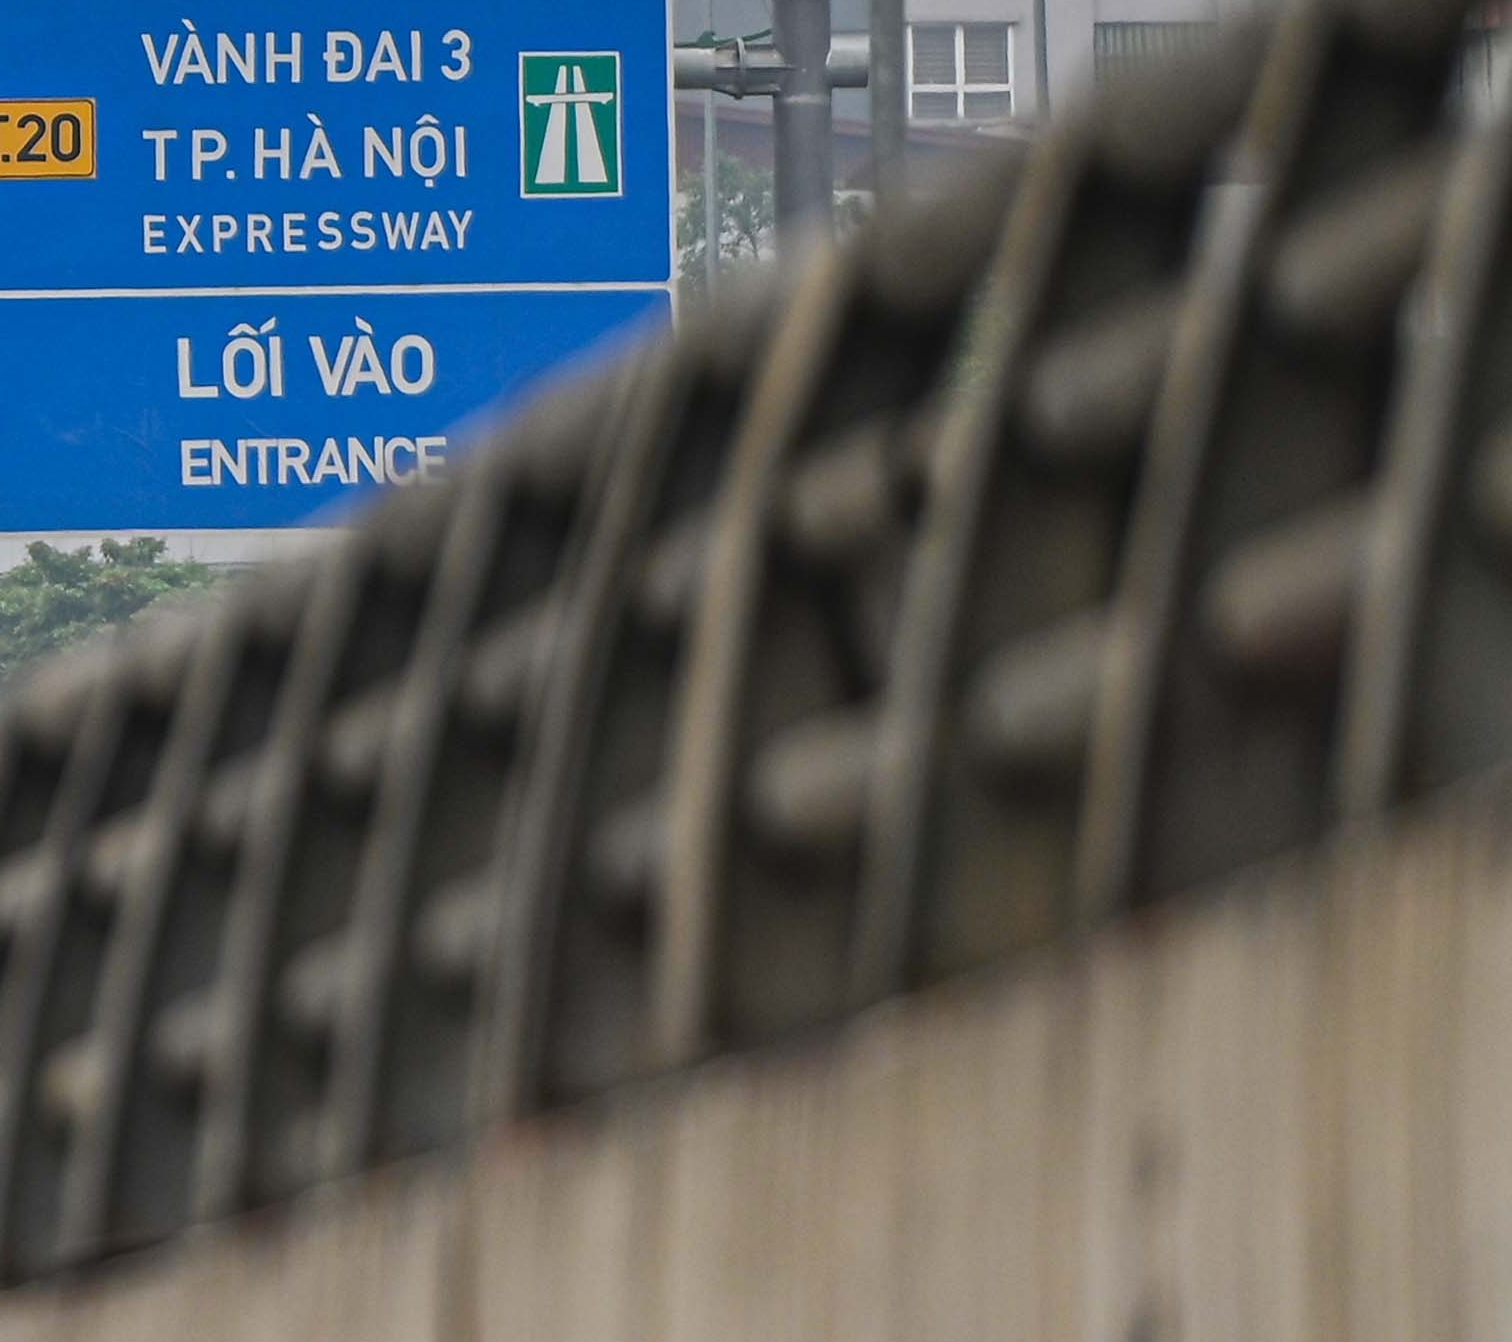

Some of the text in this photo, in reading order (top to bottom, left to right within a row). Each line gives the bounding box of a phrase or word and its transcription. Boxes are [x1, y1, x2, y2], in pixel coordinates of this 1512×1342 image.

[140, 18, 472, 85] VÀNH ĐAI 3
[363, 113, 466, 188] NỘI
[143, 209, 474, 254] EXPRESSWAY
[177, 316, 435, 398] LỐI VÀO
[180, 435, 448, 487] ENTRANCE
